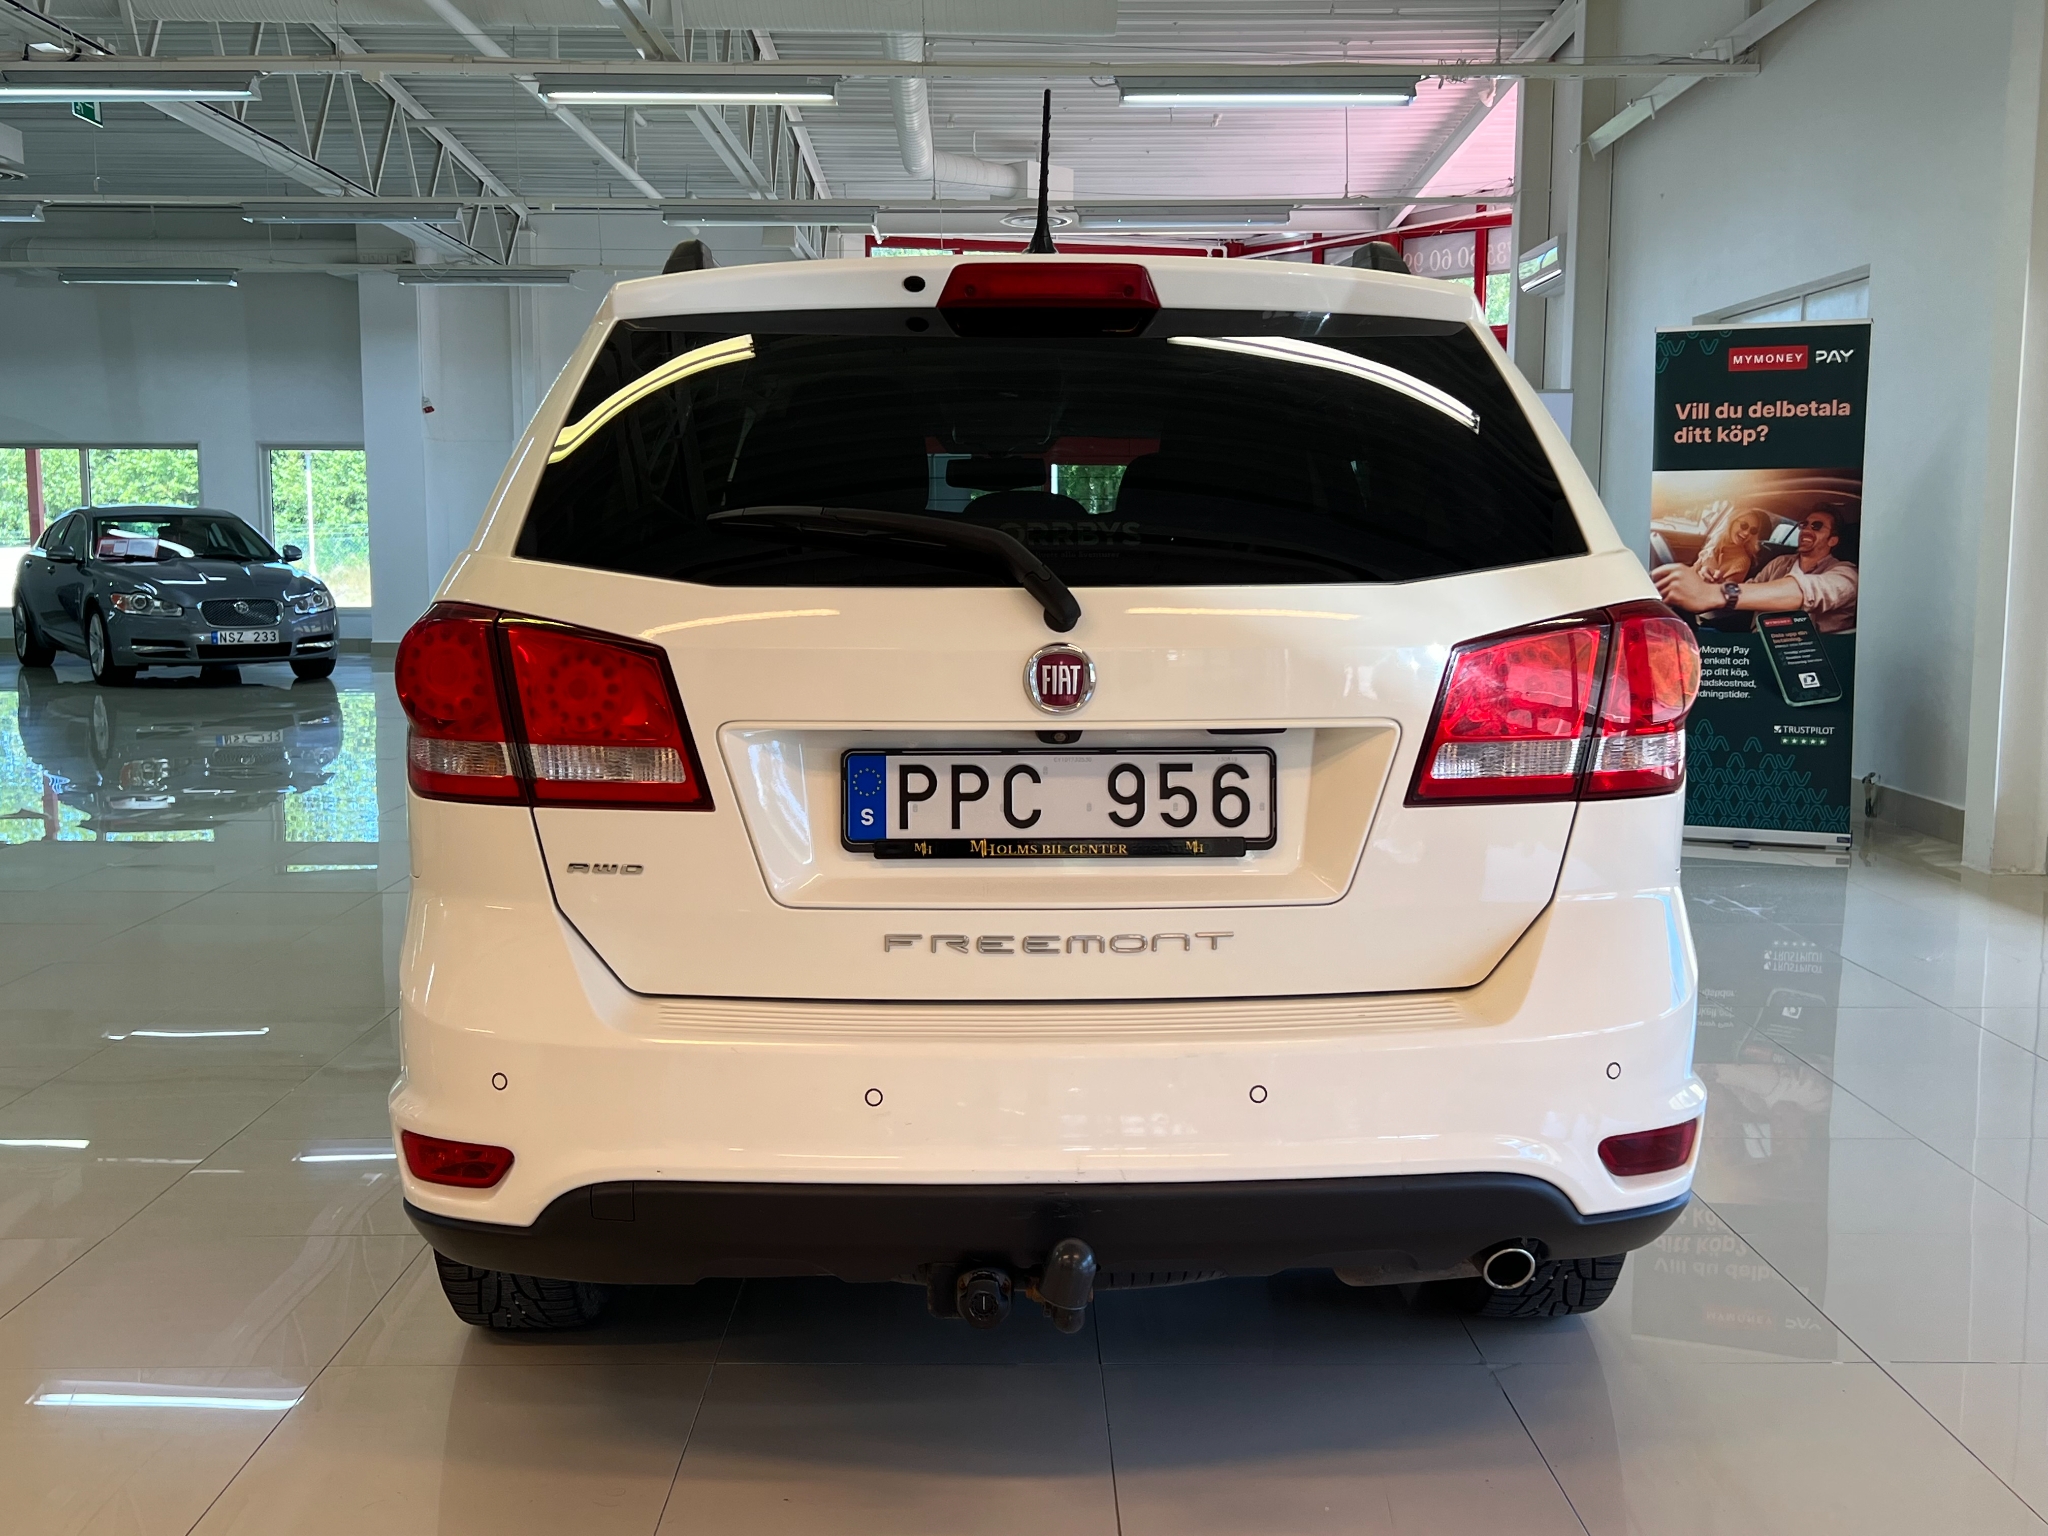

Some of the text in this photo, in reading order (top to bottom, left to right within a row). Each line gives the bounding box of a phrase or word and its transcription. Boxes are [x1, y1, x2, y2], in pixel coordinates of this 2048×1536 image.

[1732, 349, 1855, 365] MYMONEY PAY
[1675, 400, 1851, 420] Vill du delbetala
[1674, 424, 1770, 446] ditt köp?
[219, 631, 277, 643] NSZ 233
[1700, 645, 1750, 656] Money Pay
[1703, 656, 1750, 665] enkelt och
[1714, 667, 1729, 676] ditt
[1730, 667, 1750, 678] köp.
[1041, 665, 1081, 695] FIAT
[1698, 690, 1751, 699] dningstider.
[1783, 725, 1835, 735] TRUSTPILOT
[899, 763, 1251, 830] PPC 956
[860, 808, 875, 826] S
[1042, 844, 1067, 855] BIL
[1069, 844, 1128, 854] CENTER
[567, 862, 645, 876] AWD
[883, 930, 1236, 955] FREEMONT
